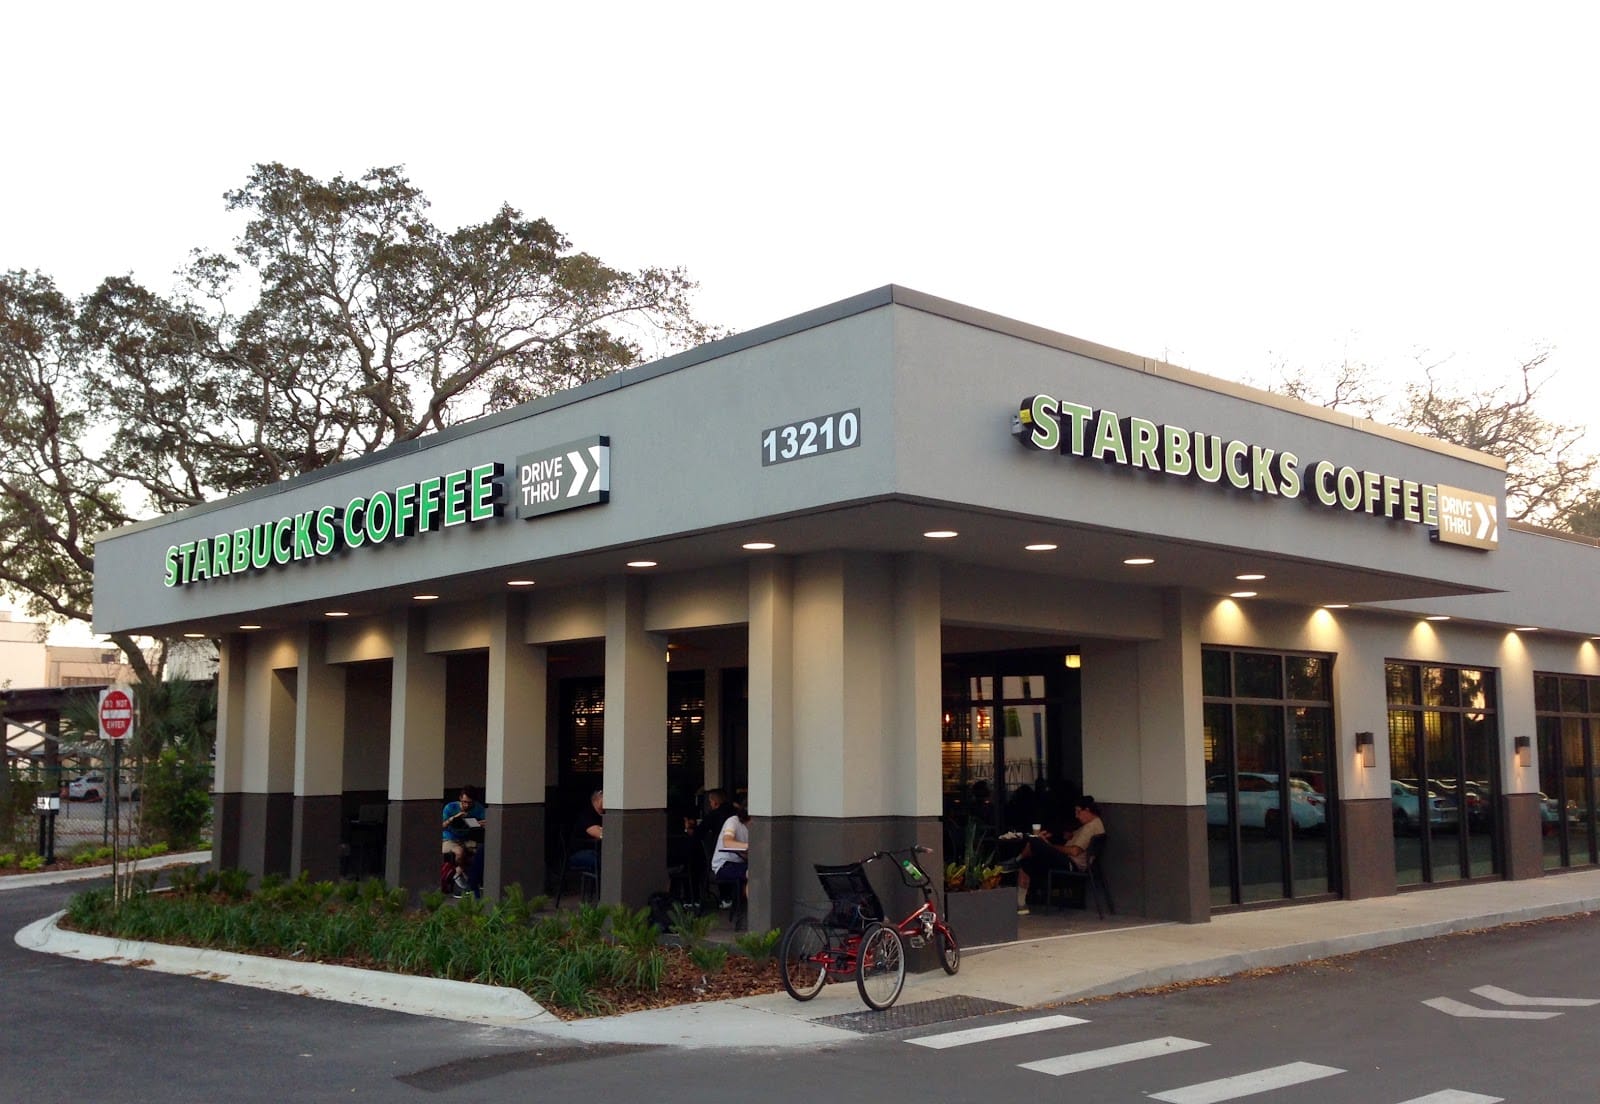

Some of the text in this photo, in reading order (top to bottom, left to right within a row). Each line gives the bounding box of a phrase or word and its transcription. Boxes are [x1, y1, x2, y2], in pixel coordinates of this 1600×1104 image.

[763, 412, 858, 463] 13210
[521, 456, 563, 484] DRIVE
[1030, 394, 1438, 526] STARBUCKS COFFEE
[521, 479, 560, 506] THRU
[1441, 495, 1473, 518] DRIVE
[164, 462, 494, 587] STARBUCKS COFFEE
[1444, 514, 1471, 536] THRU
[104, 699, 128, 708] DO NOT
[106, 720, 125, 729] ENTER
